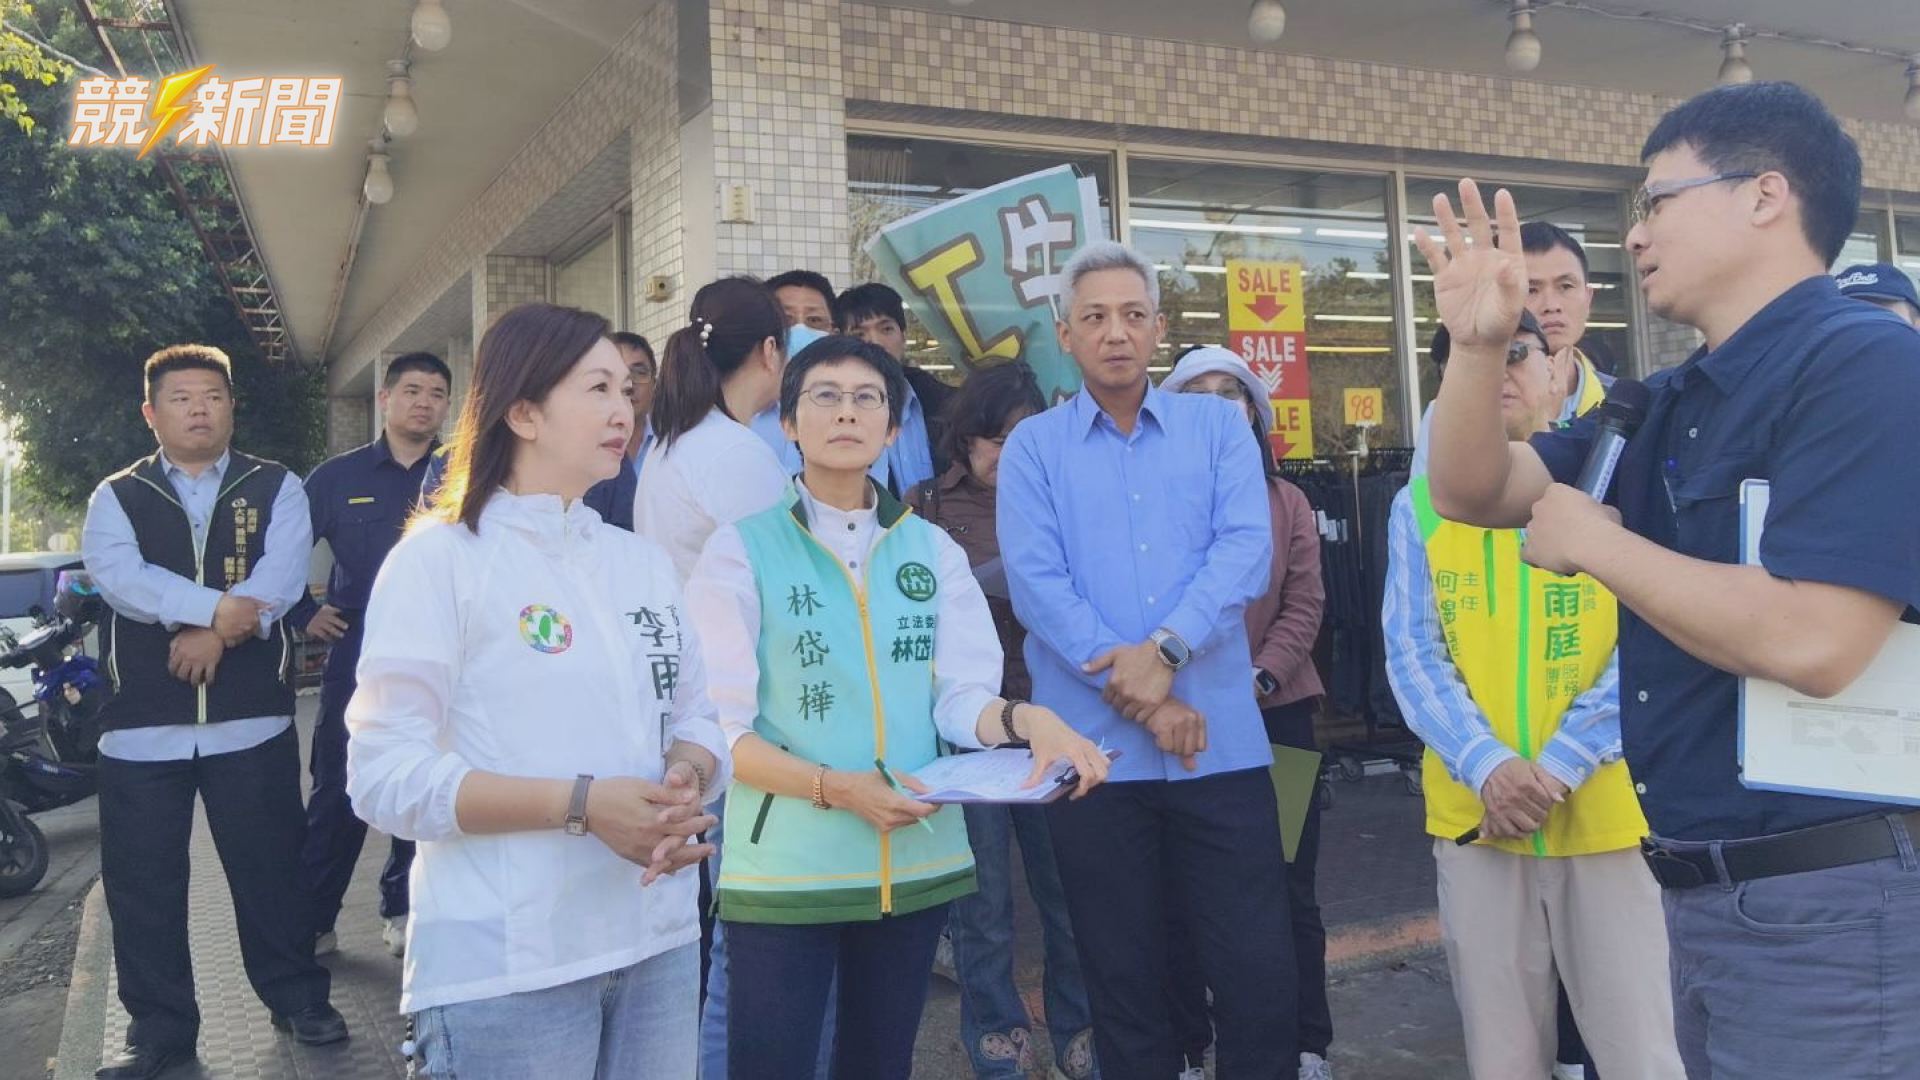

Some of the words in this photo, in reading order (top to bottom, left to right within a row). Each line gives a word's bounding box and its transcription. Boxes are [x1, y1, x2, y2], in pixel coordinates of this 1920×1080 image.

[1238, 267, 1292, 293] SALE
[1241, 335, 1296, 362] SALE
[1270, 406, 1300, 432] LE
[1350, 395, 1374, 420] 98
[900, 566, 932, 598] 岱
[786, 583, 836, 724] 林岱樺
[624, 606, 681, 758] 李雨
